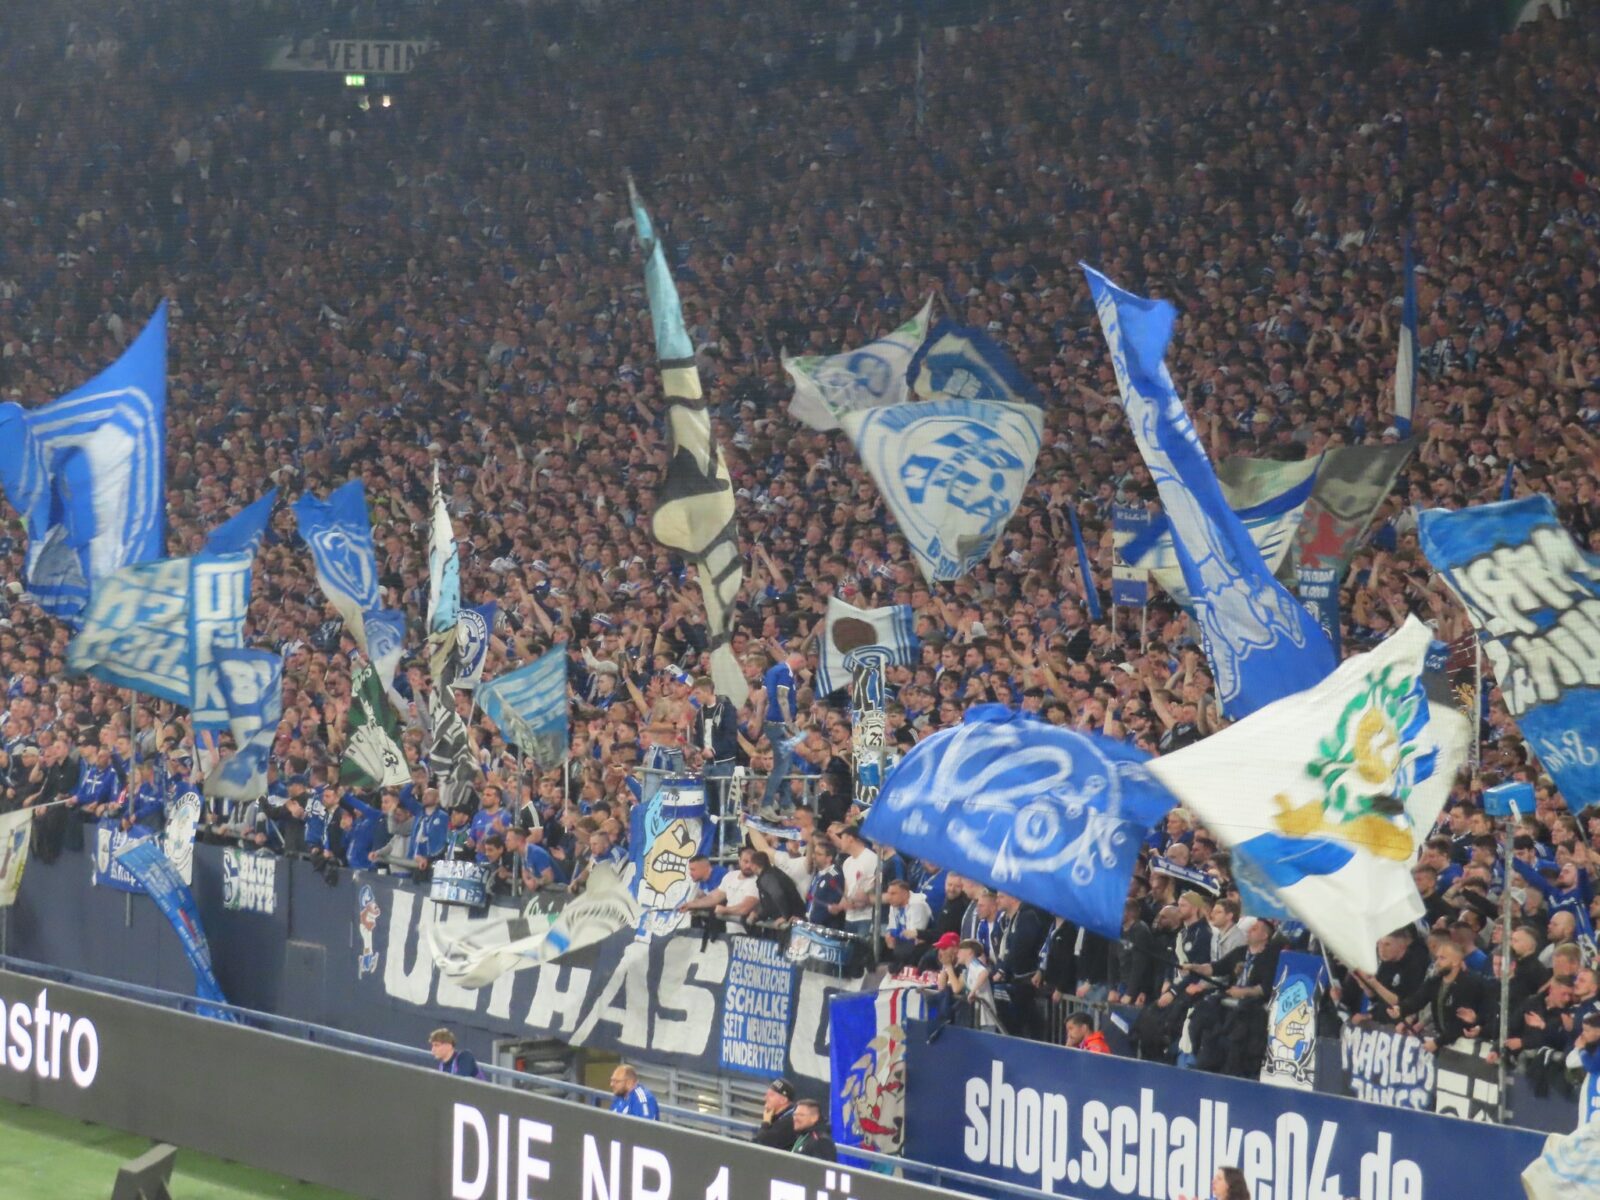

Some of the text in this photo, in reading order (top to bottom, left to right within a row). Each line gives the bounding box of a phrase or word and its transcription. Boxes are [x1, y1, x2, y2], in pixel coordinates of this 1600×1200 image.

[326, 42, 424, 70] VELTIN
[729, 960, 791, 995] GELSENKIRCHEN
[725, 985, 789, 1021] SCHALKE
[0, 987, 99, 1089] stro
[723, 1012, 787, 1047] SEIT NEUNZEHN
[722, 1038, 785, 1072] HUNDERTVIER
[1341, 1026, 1435, 1091] MARLER
[964, 1059, 1423, 1200] shop.schalke04de
[452, 1102, 553, 1200] DIE
